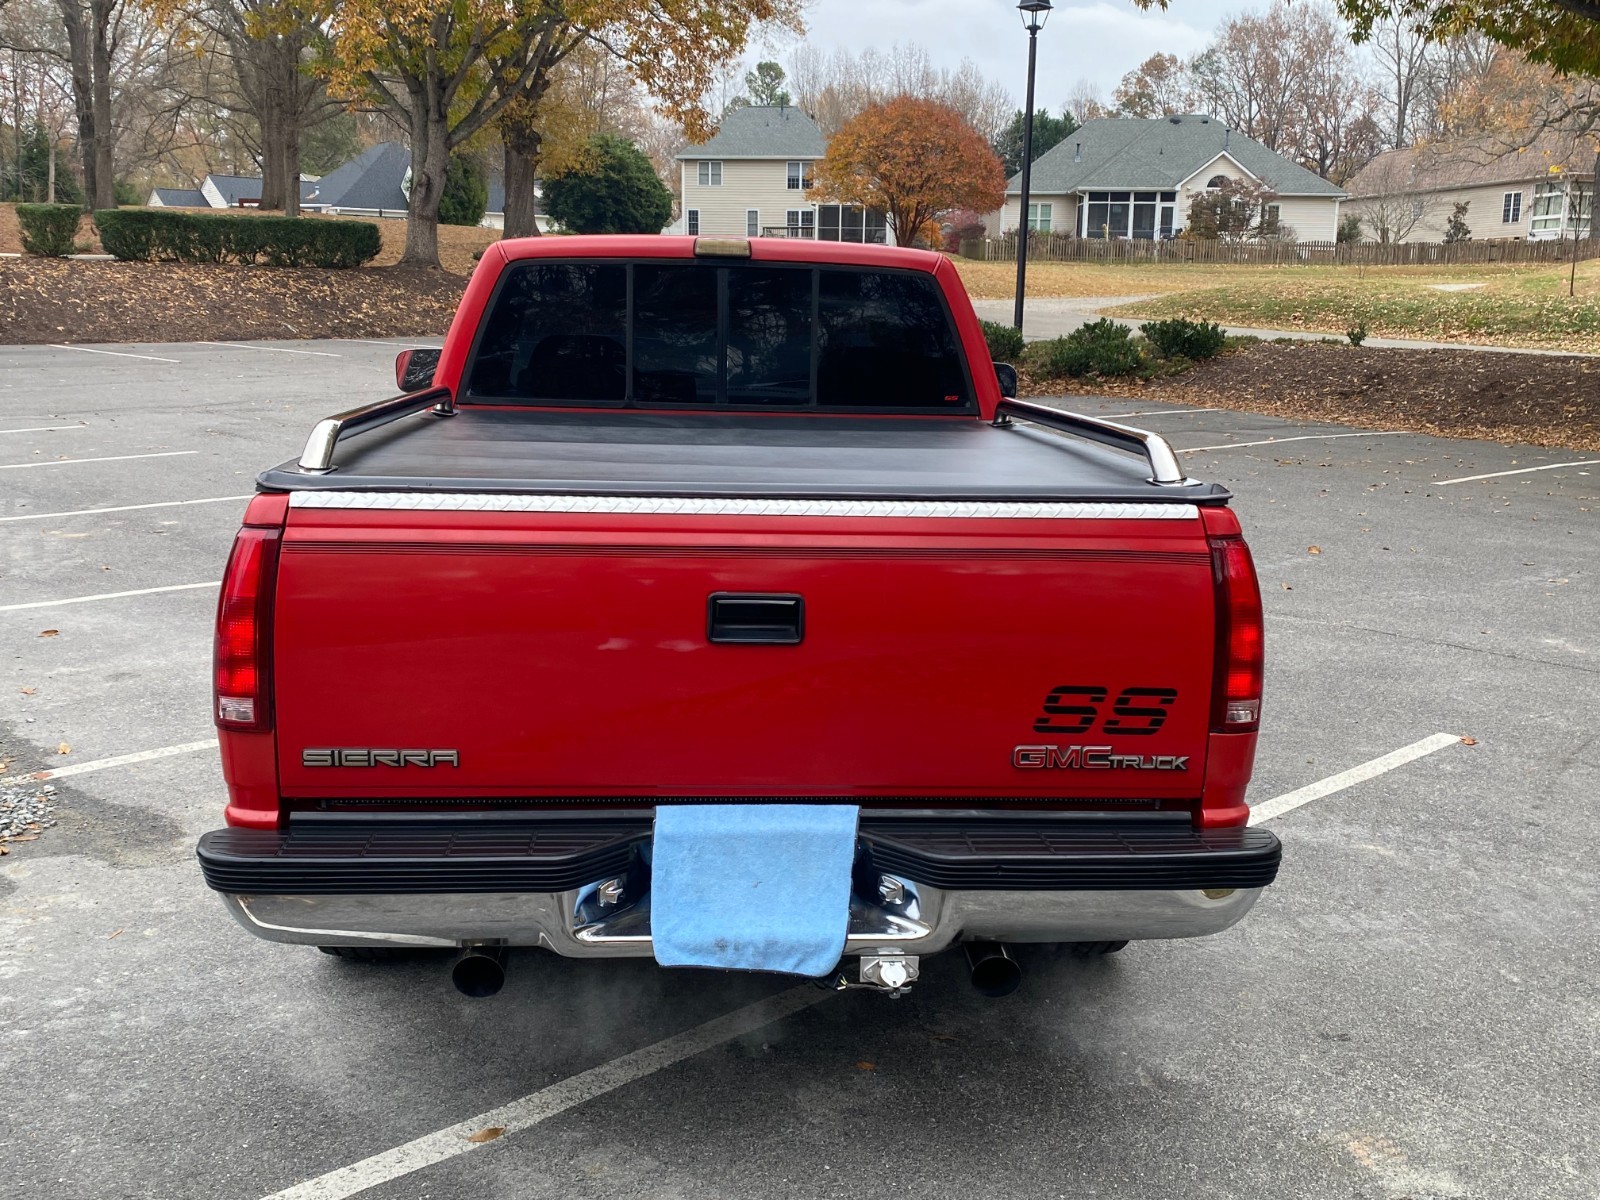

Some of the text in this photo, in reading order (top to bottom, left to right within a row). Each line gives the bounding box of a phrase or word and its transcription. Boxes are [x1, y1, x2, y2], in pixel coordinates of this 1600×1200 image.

[1033, 685, 1178, 735] SS
[302, 748, 459, 767] SIERRA
[1013, 745, 1190, 770] GMC TRUCK
